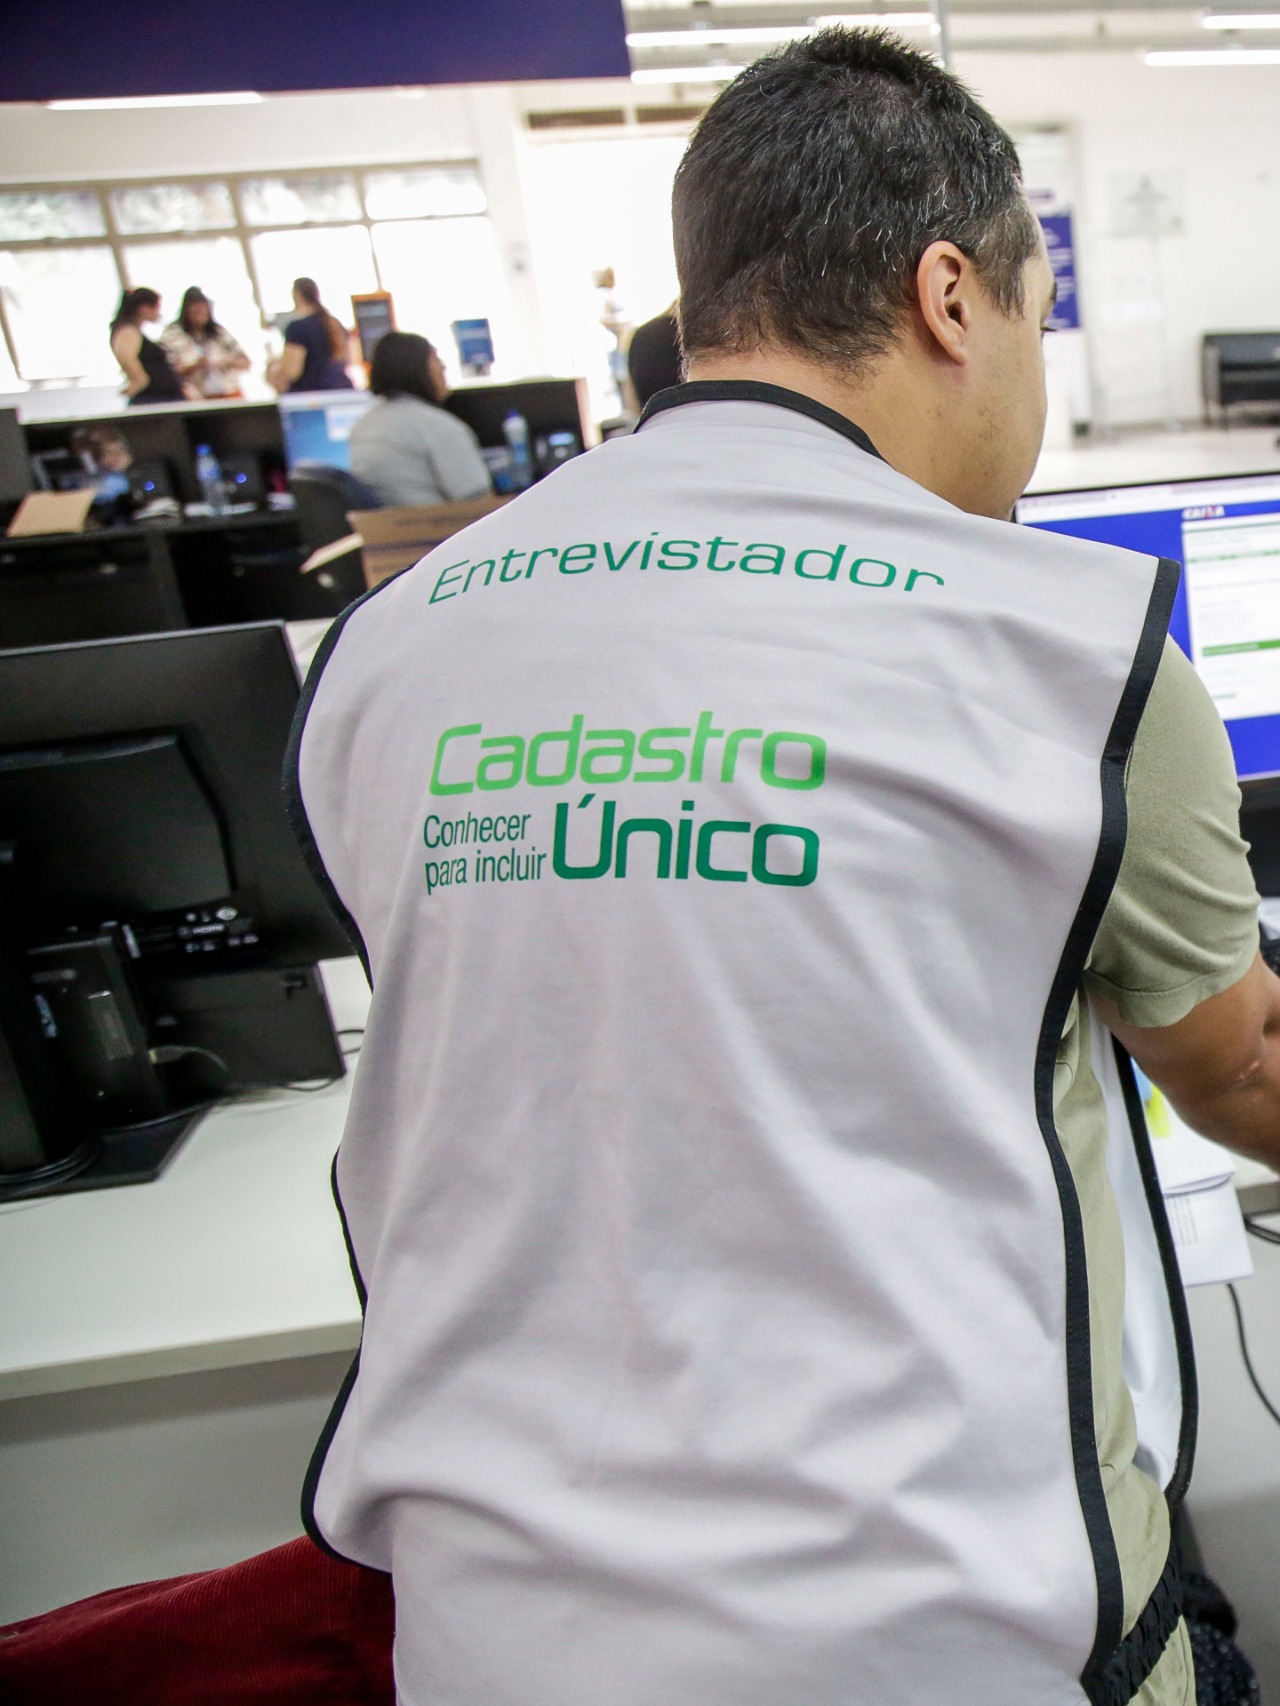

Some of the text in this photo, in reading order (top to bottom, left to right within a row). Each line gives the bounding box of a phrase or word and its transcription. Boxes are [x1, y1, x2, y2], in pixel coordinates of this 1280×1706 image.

[428, 531, 945, 605] Entrevistador
[428, 710, 828, 797] Cadastro
[422, 811, 532, 850] Conhecer
[551, 793, 821, 888] Único
[424, 846, 548, 896] para incluir
